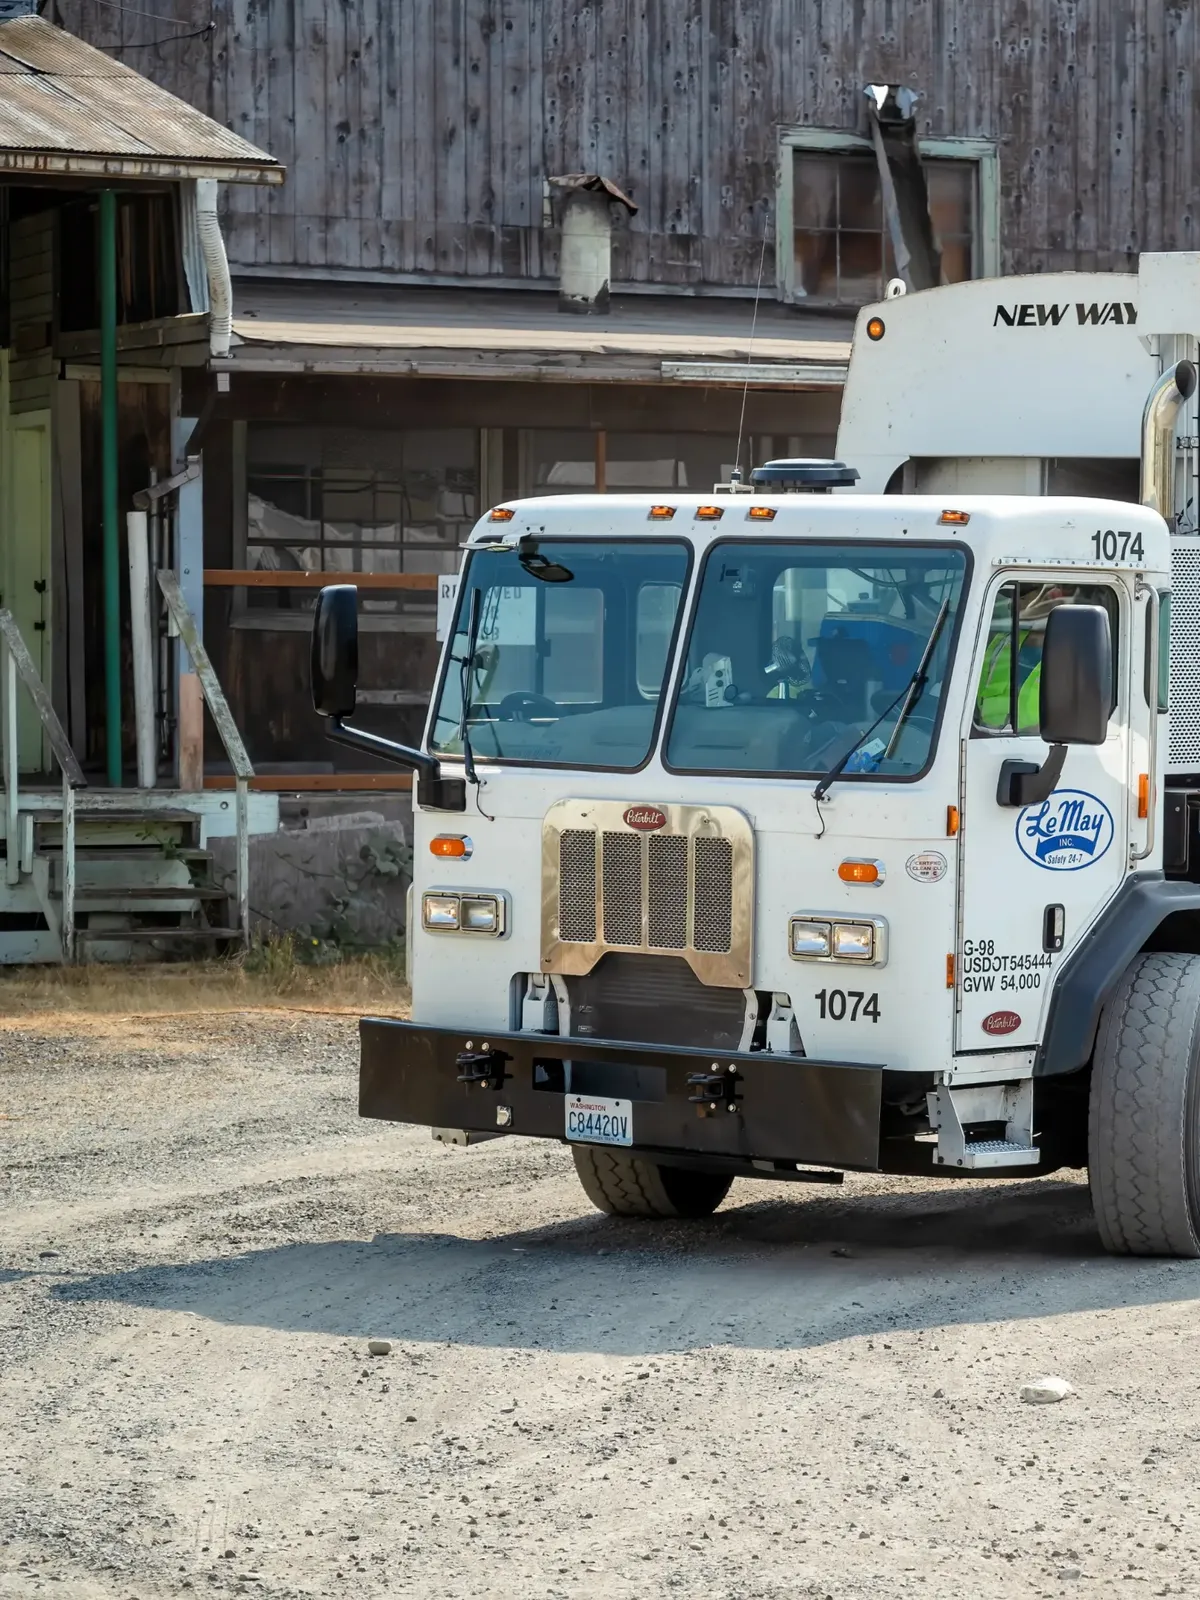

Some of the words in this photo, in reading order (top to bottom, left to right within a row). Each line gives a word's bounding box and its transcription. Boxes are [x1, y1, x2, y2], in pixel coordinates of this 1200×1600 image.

[993, 304, 1070, 326] NEW
[1075, 302, 1138, 325] WAY
[1091, 529, 1144, 561] 1074
[627, 809, 662, 824] Peterbilt
[1059, 838, 1074, 847] INC.
[1047, 855, 1066, 865] Safety
[1068, 854, 1083, 864] 24-7
[964, 940, 994, 956] G-98
[964, 976, 995, 992] GVW
[1000, 973, 1040, 992] 54,000
[815, 989, 881, 1023] 1074
[986, 1016, 1018, 1030] Peterbilt
[570, 1102, 606, 1111] WASHINGTON
[569, 1111, 627, 1138] C84420V
